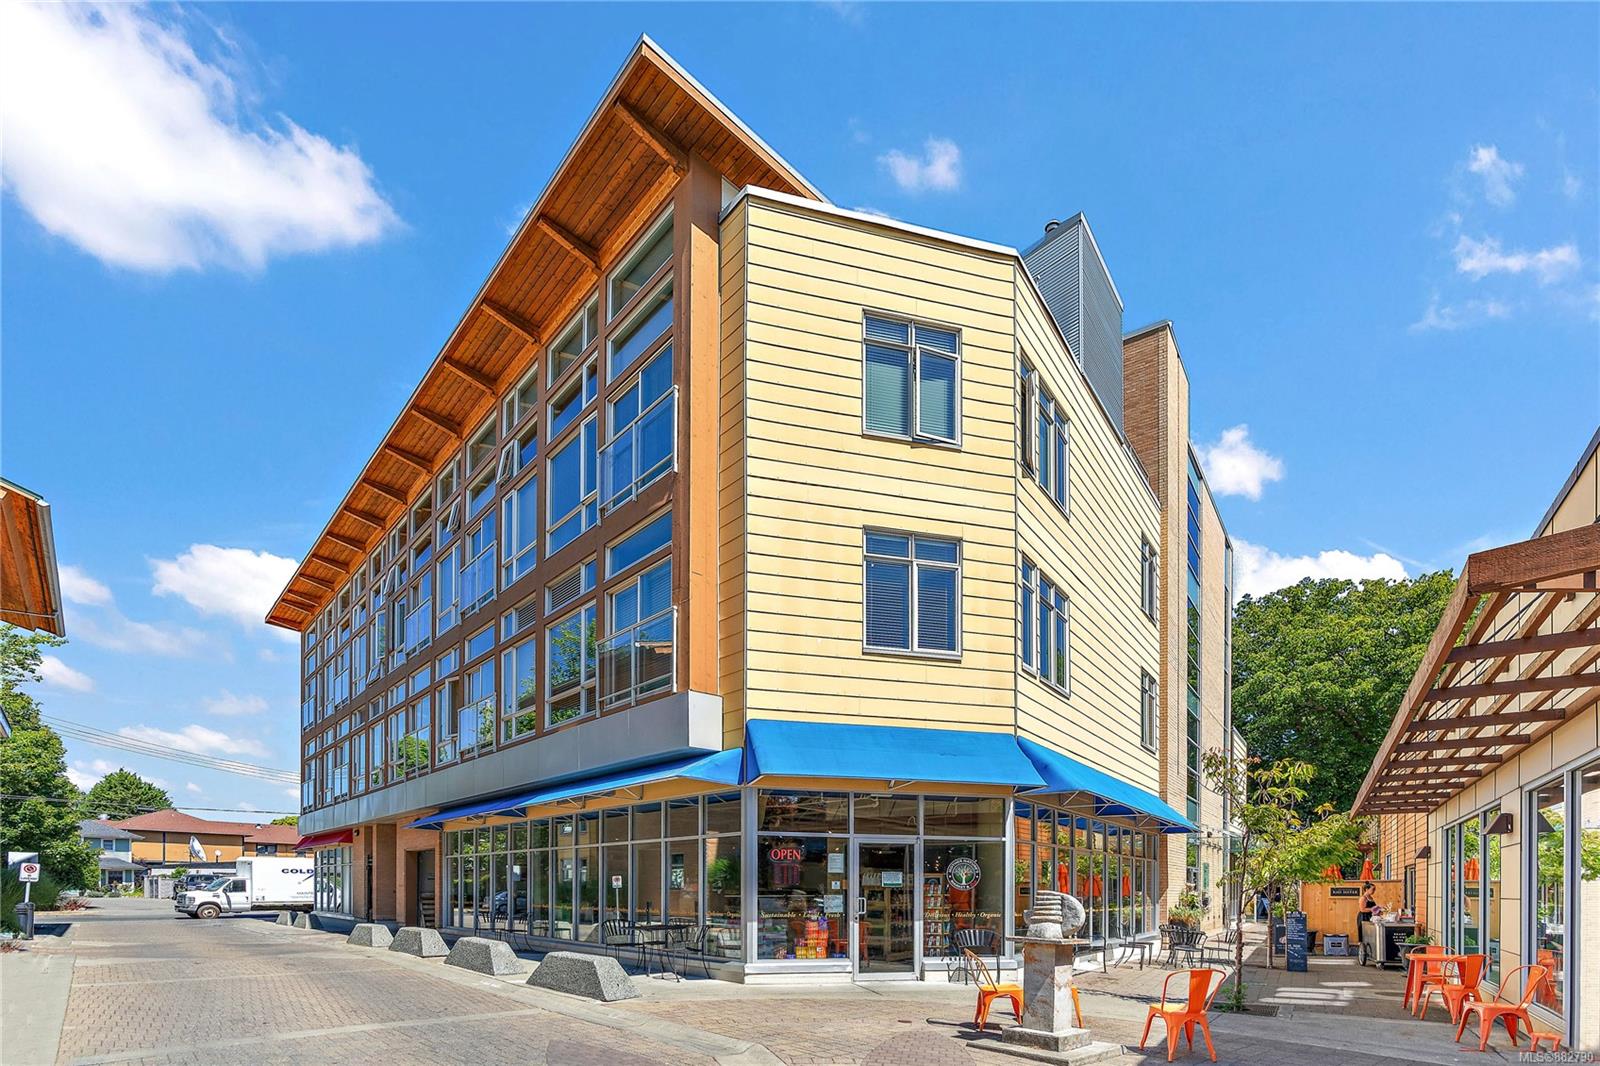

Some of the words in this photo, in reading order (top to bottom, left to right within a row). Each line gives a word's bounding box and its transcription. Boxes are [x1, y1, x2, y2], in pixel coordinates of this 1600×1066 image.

[771, 848, 800, 860] OPEN
[760, 911, 796, 919] Sustainable
[955, 911, 976, 919] Healthy
[979, 911, 1001, 919] Organic
